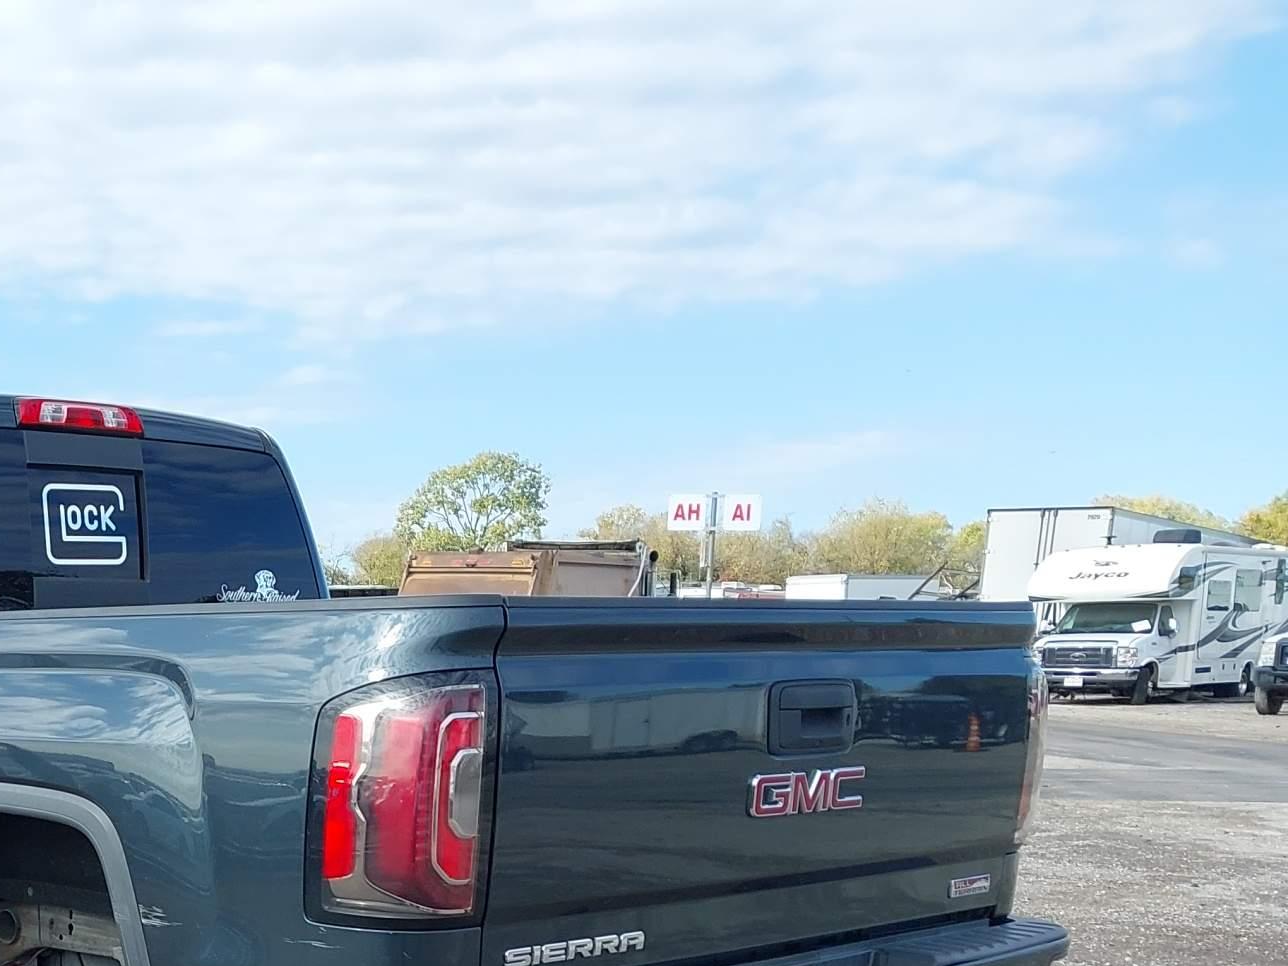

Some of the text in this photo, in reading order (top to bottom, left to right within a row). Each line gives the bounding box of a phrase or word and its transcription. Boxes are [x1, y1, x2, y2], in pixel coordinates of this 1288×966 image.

[673, 503, 701, 521] AH
[732, 503, 752, 521] AI
[1068, 571, 1130, 581] Jayco
[216, 584, 263, 604] Southern
[746, 765, 866, 817] GMC
